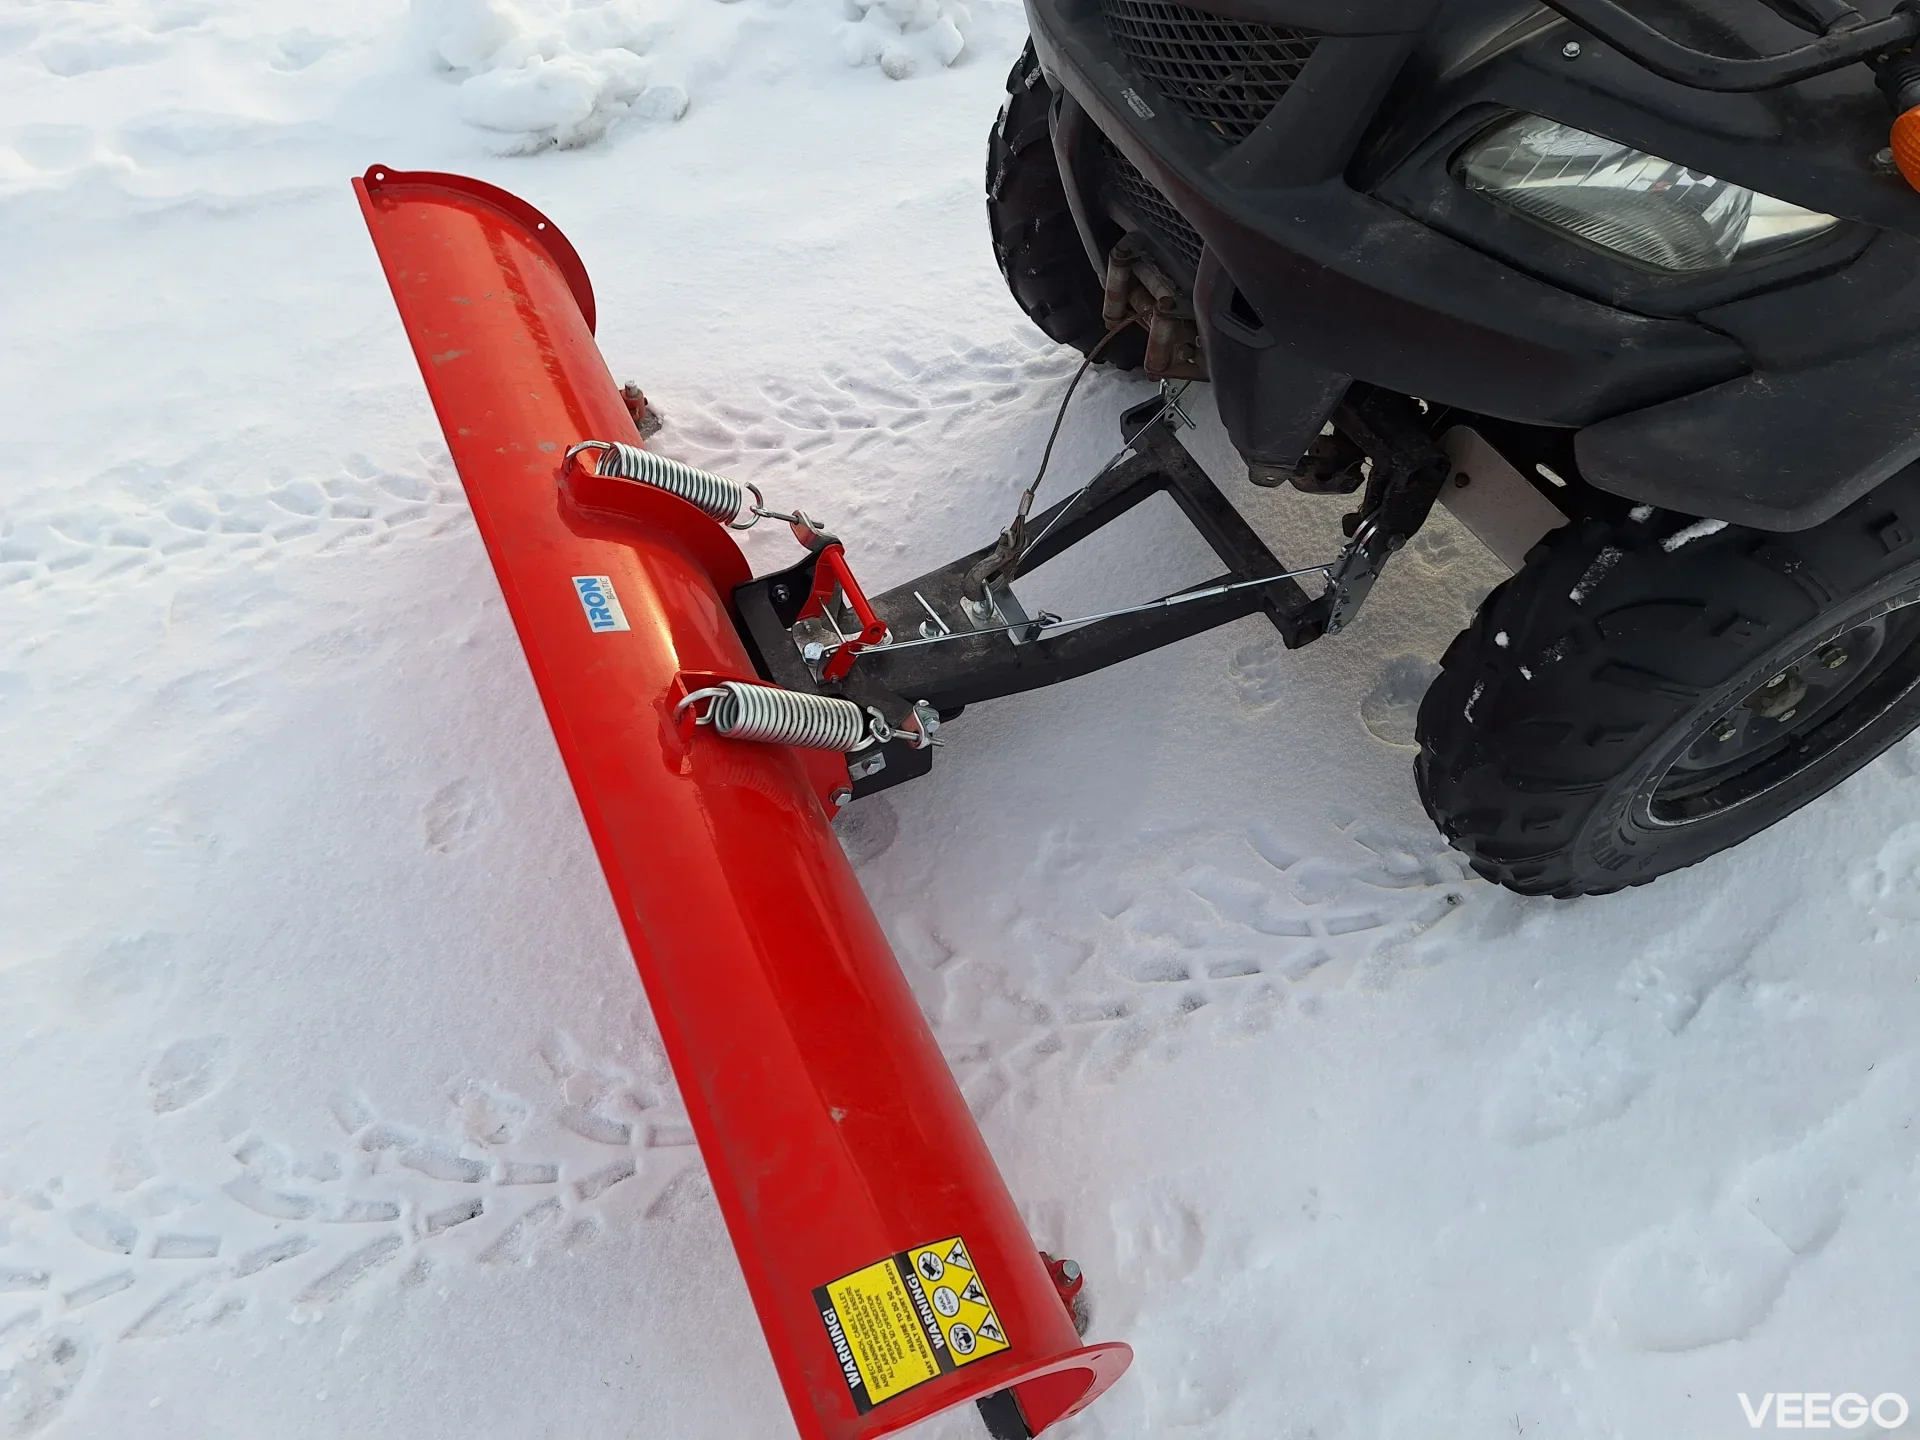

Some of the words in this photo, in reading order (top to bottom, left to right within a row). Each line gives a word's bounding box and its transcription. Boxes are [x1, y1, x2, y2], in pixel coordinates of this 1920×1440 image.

[600, 577, 615, 600] BALTIC
[577, 578, 615, 628] IRON
[884, 1262, 897, 1285] DEATH
[838, 1292, 852, 1315] PULLEY
[845, 1286, 859, 1310] ENSURE
[854, 1288, 865, 1304] SAFE
[898, 1296, 913, 1322] INJURY
[866, 1295, 883, 1328] CONDITION
[906, 1272, 945, 1349] WARNING!
[867, 1318, 881, 1344] PROPER
[900, 1323, 916, 1352] FAILURE
[821, 1308, 862, 1388] WARNING!
[866, 1339, 884, 1373] RETAINING
[879, 1329, 898, 1364] OPERATING
[892, 1339, 904, 1359] PRIOR
[913, 1332, 928, 1359] RESULT
[866, 1363, 881, 1389] INSPECT
